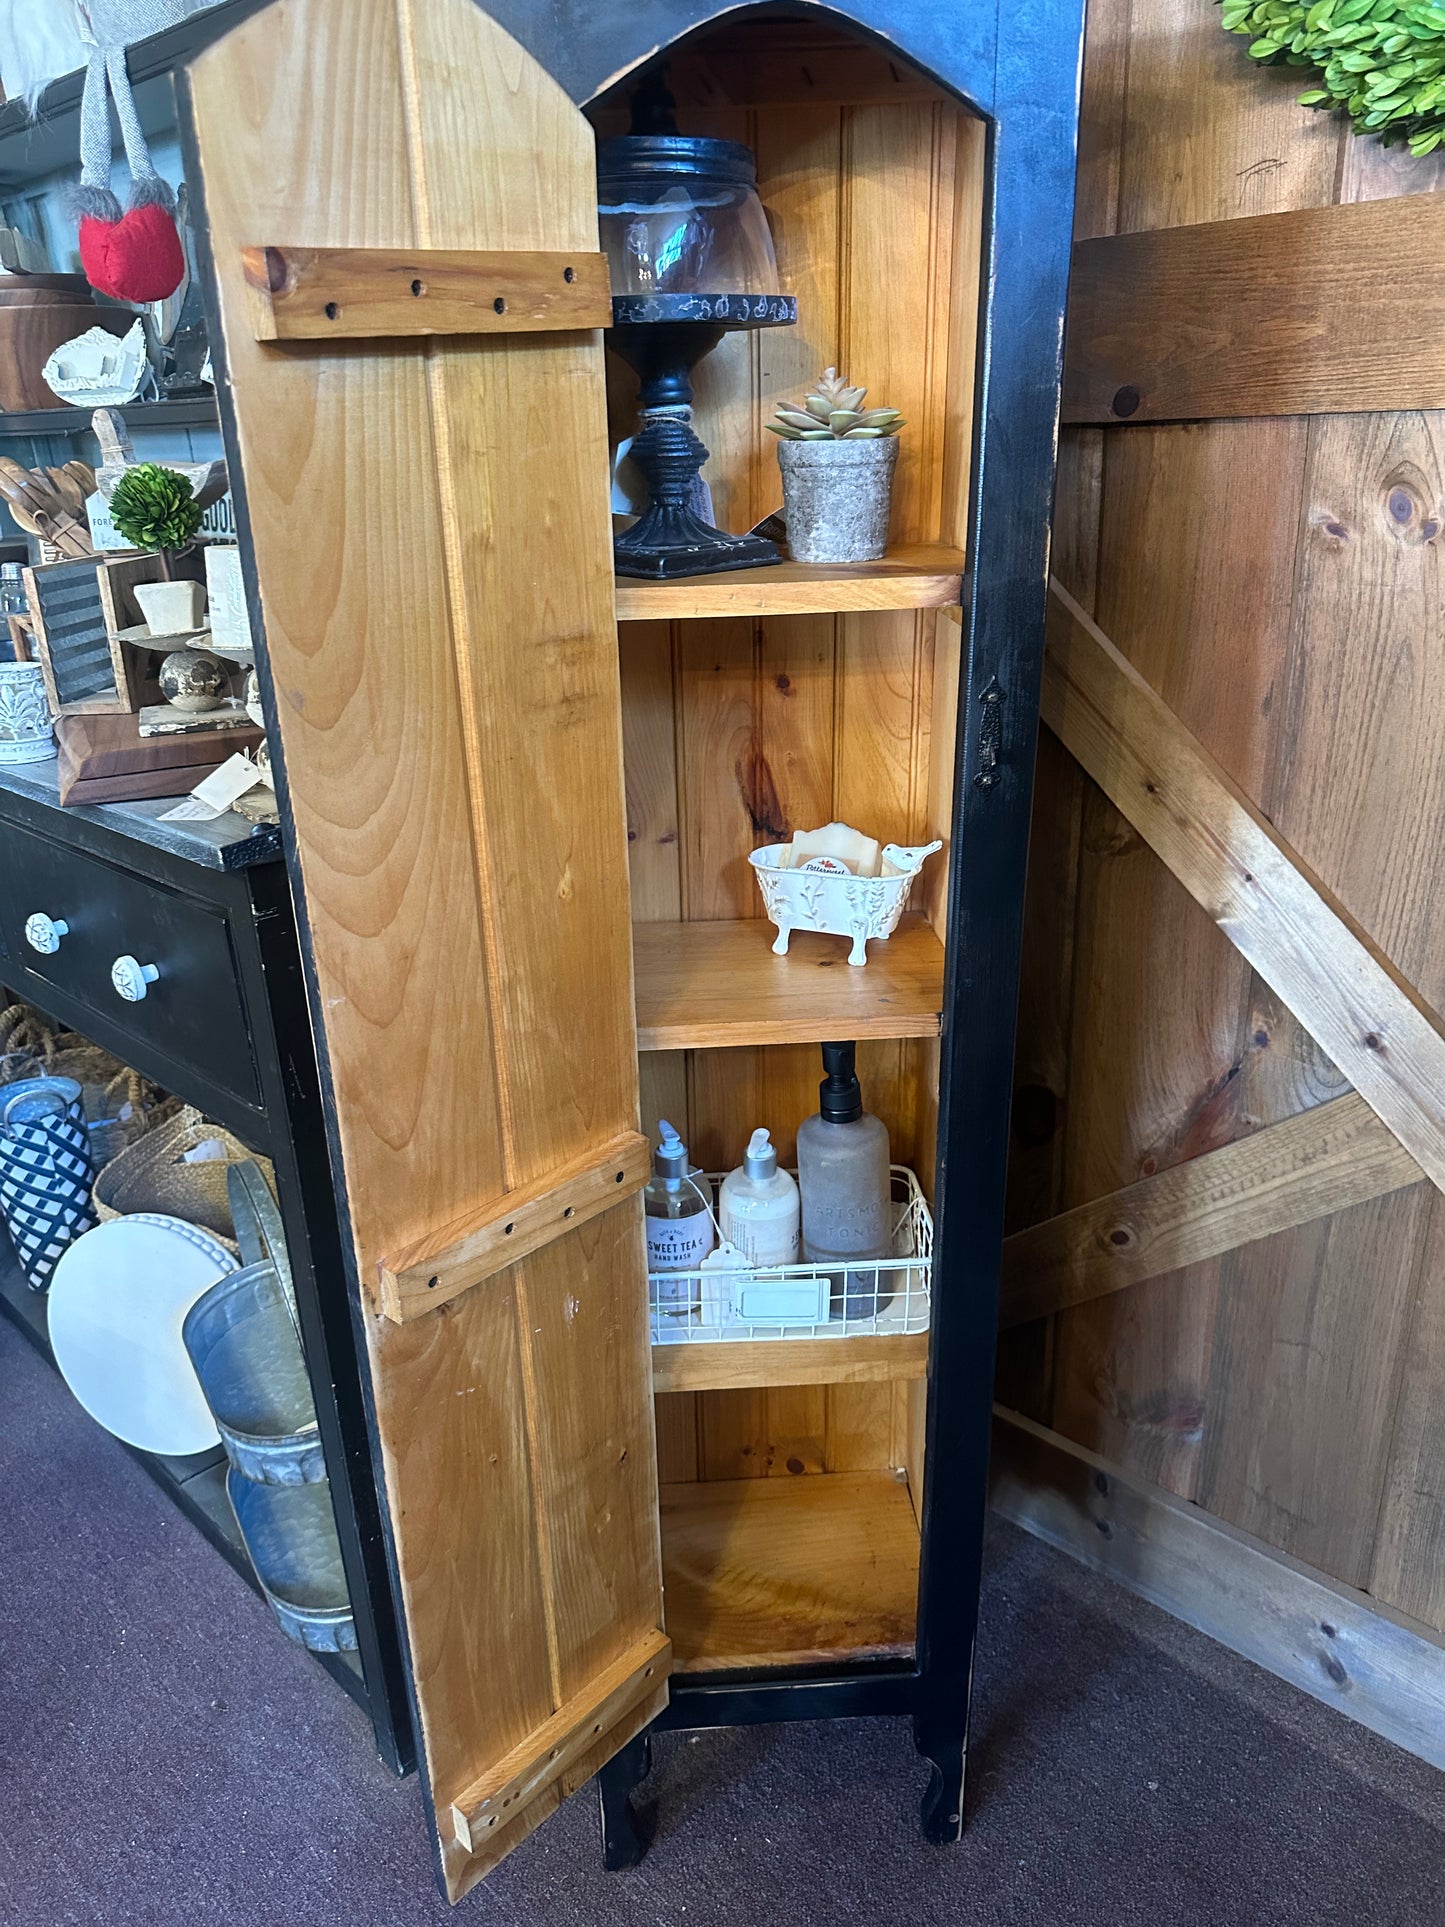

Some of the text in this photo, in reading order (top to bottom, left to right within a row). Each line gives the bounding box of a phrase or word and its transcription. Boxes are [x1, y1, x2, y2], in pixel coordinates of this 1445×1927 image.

[648, 1240, 678, 1253] SWEET
[680, 1239, 697, 1252] TEA
[654, 1252, 691, 1262] HAND WASH
